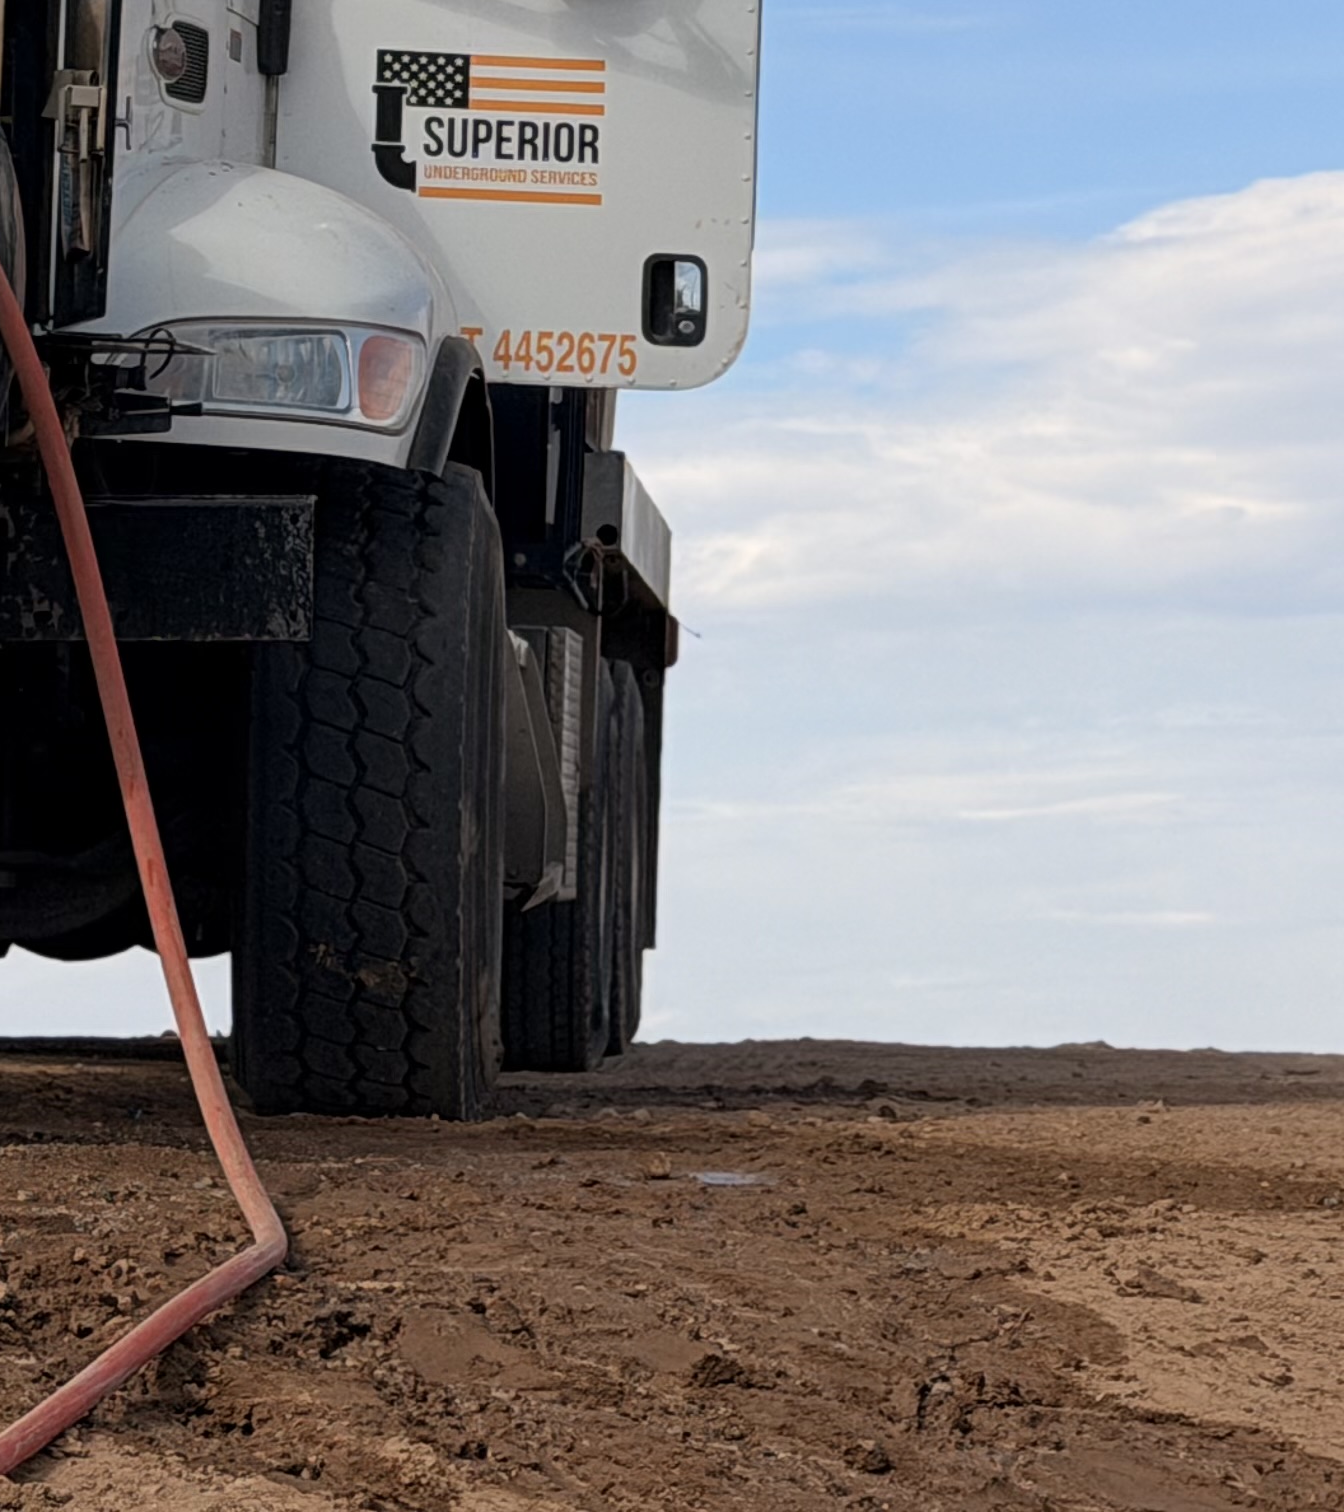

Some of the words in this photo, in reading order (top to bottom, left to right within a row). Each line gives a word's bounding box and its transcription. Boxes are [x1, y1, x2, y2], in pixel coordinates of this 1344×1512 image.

[423, 117, 599, 164] SUPERIOR
[423, 165, 527, 184] UNDERGROUND
[530, 169, 598, 186] SERVICES
[493, 329, 637, 375] 4452675
